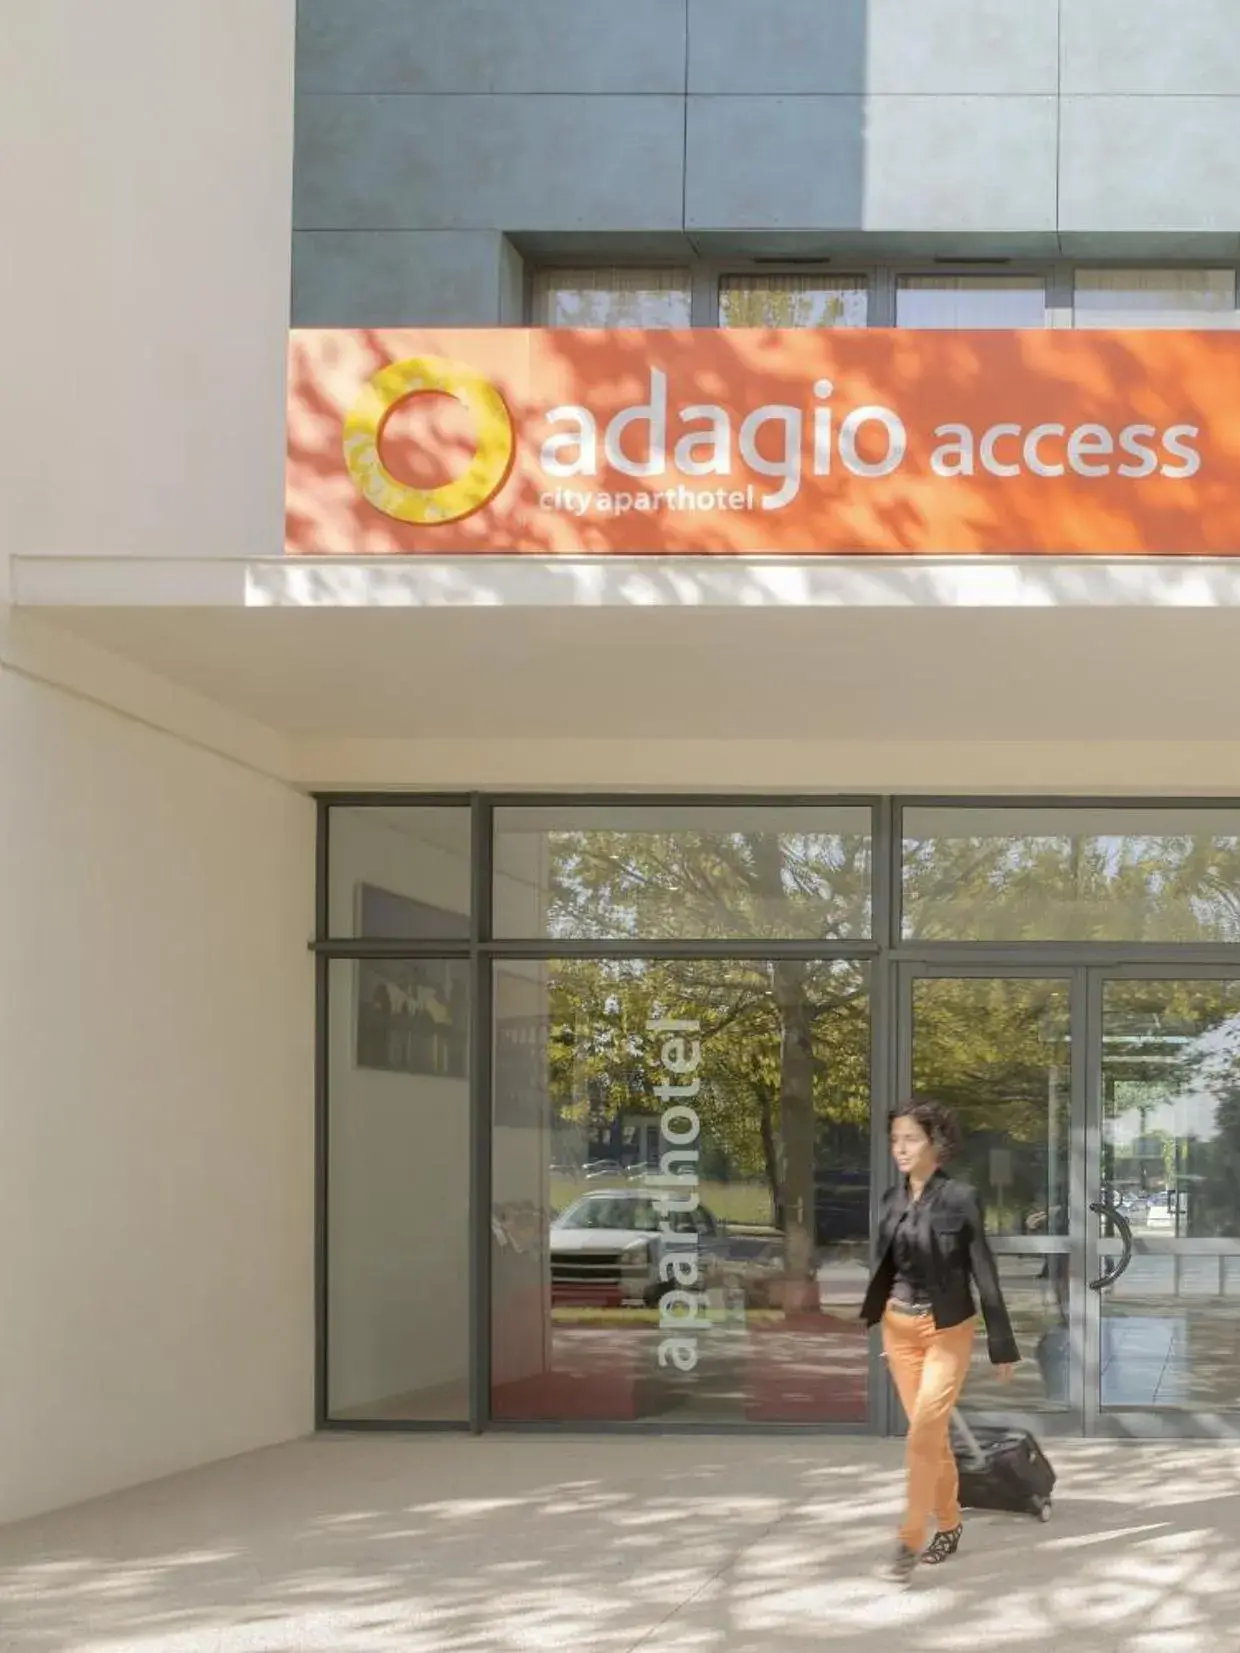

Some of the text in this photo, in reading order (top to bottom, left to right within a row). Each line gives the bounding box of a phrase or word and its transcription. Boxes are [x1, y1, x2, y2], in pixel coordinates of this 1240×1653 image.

[539, 484, 754, 516] city aparthotel
[540, 365, 1201, 511] adagio access
[643, 1018, 712, 1372] aparthotel
